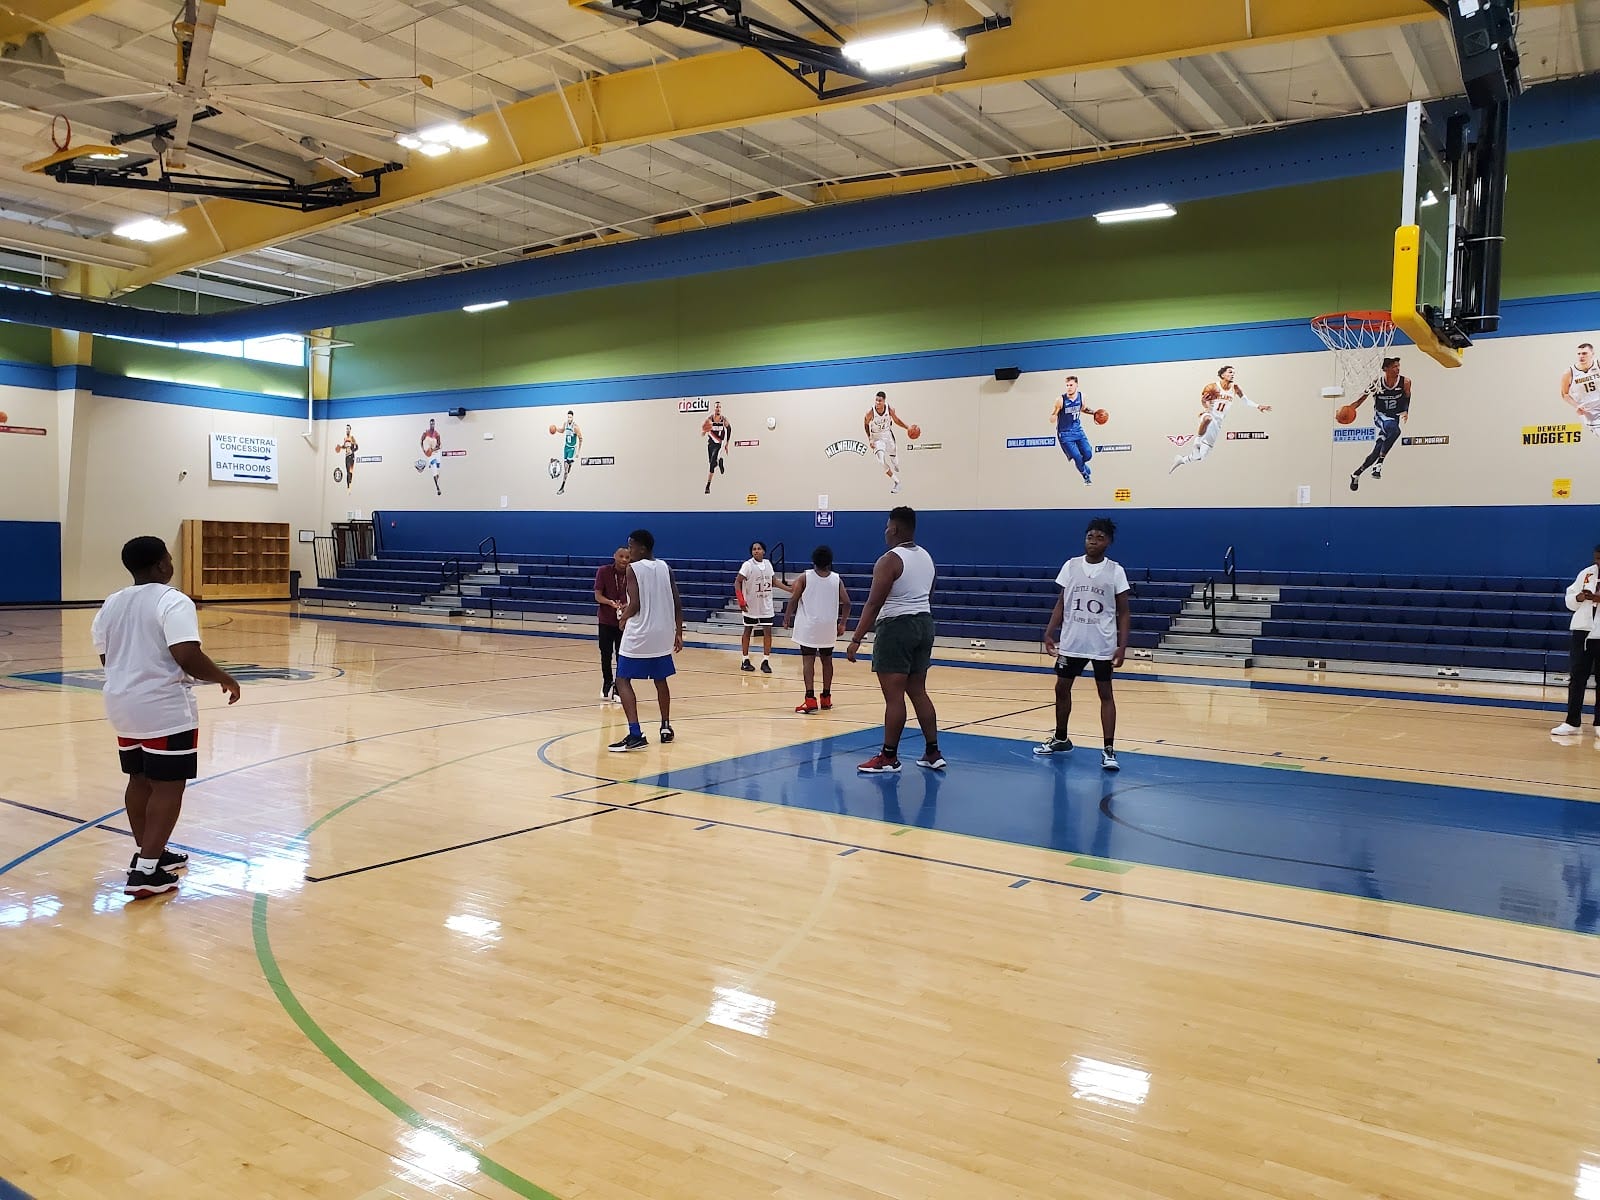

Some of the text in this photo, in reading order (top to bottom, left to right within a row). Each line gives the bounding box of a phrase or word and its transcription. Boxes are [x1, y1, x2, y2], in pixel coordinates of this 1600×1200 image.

[1584, 382, 1596, 393] 15
[1216, 402, 1226, 412] 11
[1384, 400, 1397, 410] 12
[1334, 428, 1375, 437] MEMPHIS
[1523, 431, 1581, 445] NUGGETS
[215, 434, 276, 447] WEST CENTRAL
[1007, 439, 1026, 447] DALLAS
[220, 443, 271, 454] CONCESSION
[825, 440, 868, 458] MILWAUKEE
[216, 461, 271, 473] BATHROOMS
[755, 582, 771, 592] 12
[1072, 598, 1104, 614] 10
